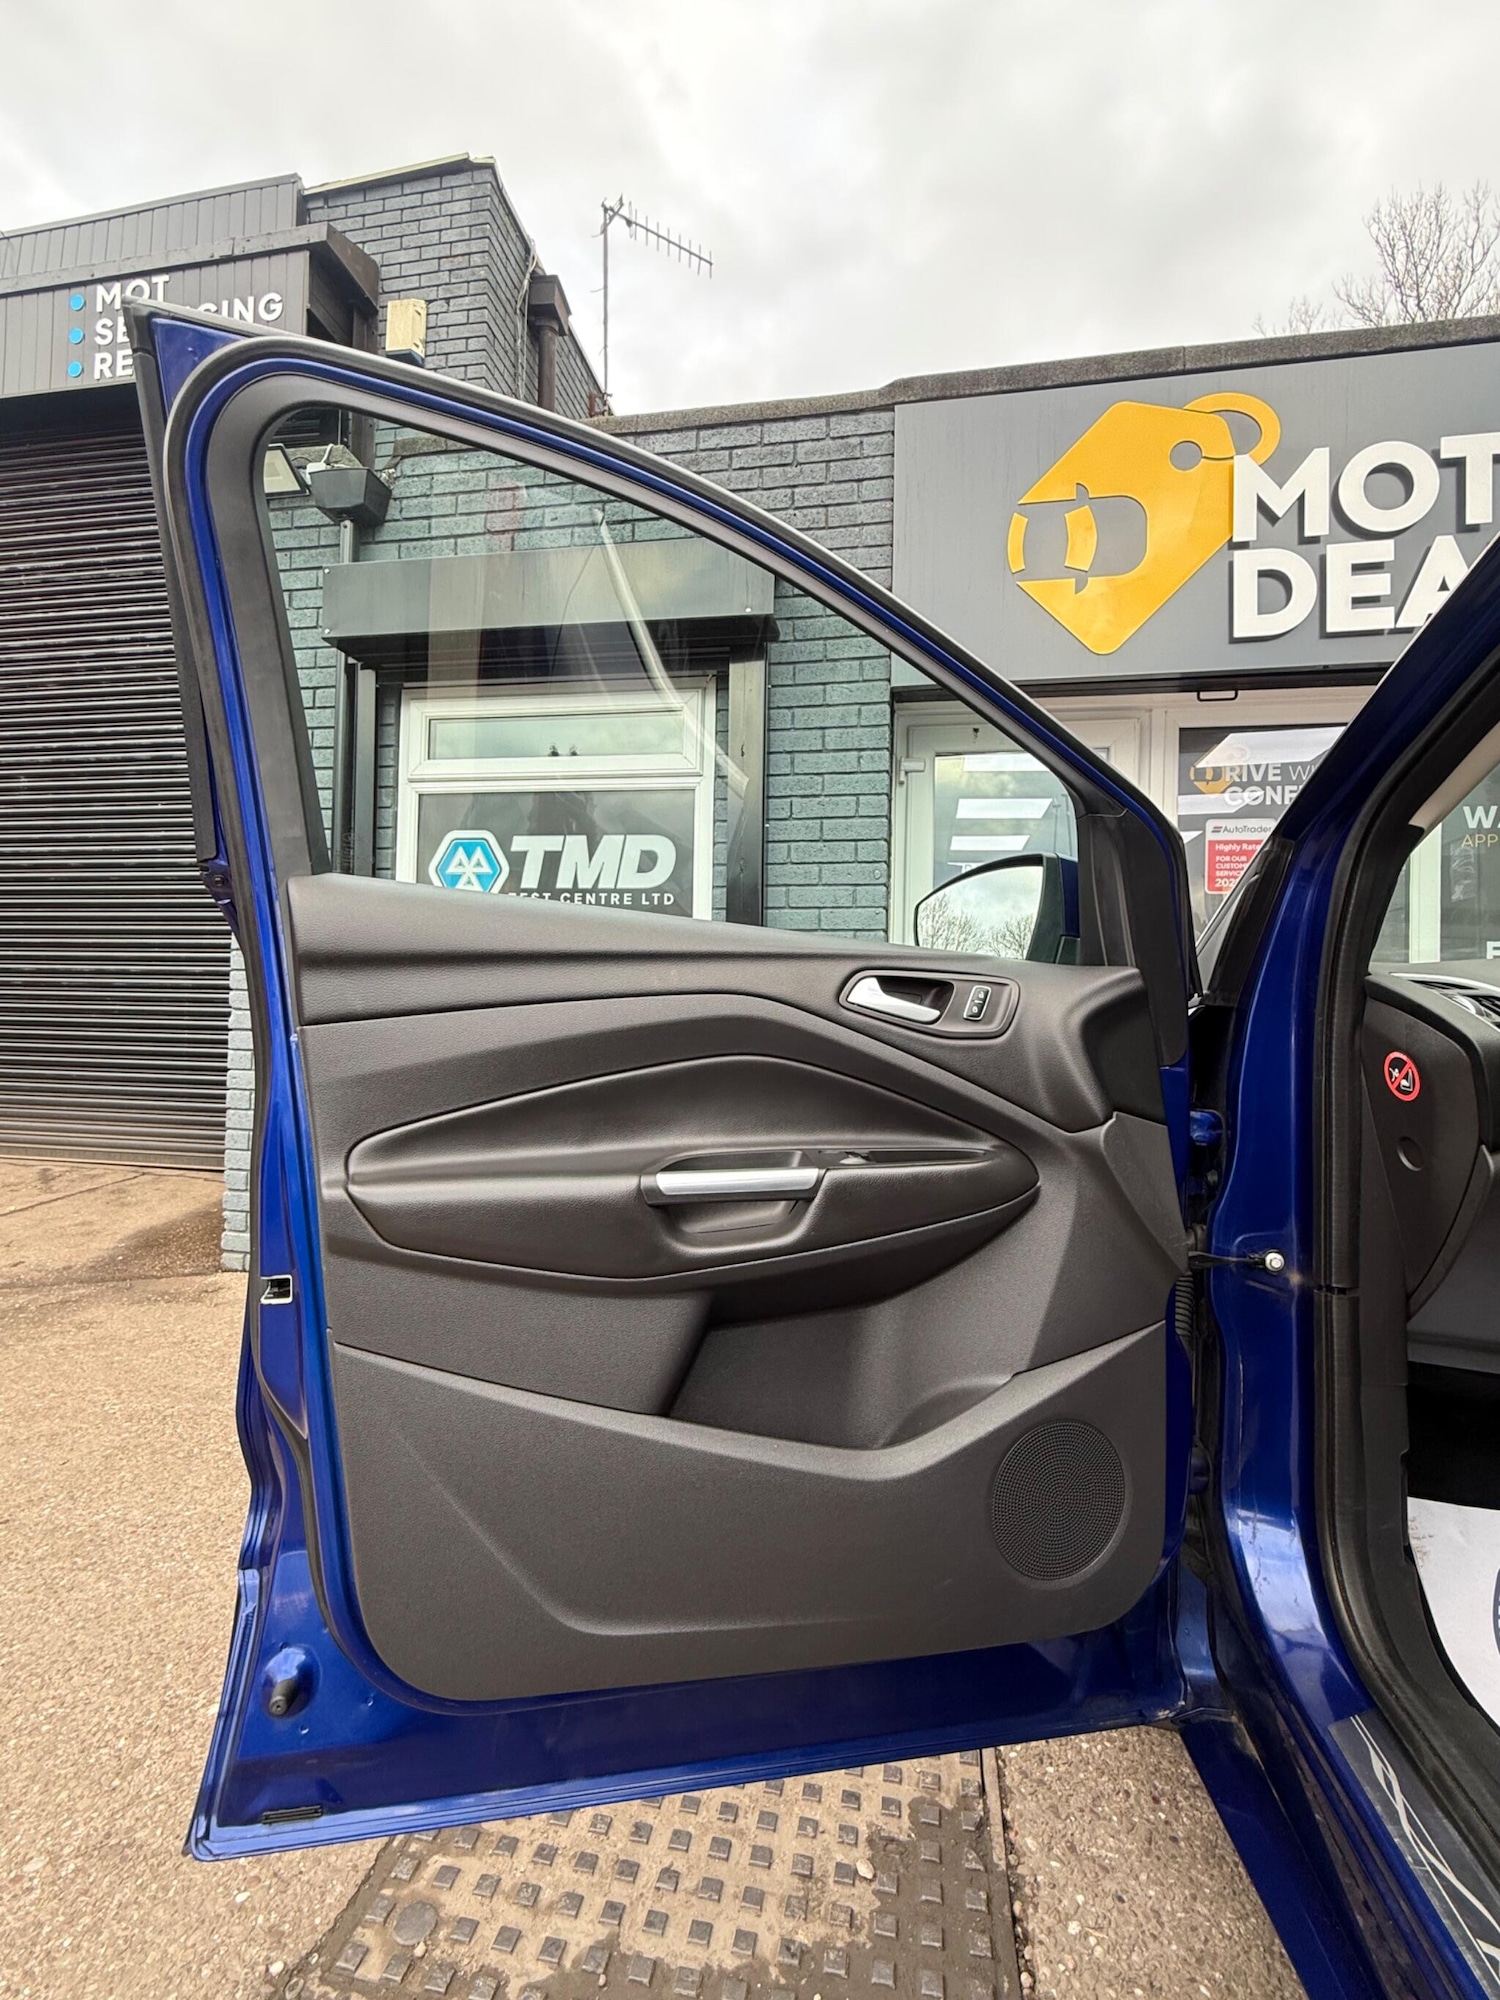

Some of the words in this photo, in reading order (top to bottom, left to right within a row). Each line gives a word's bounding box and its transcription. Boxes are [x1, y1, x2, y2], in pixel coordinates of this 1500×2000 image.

[95, 274, 170, 313] MOT
[1215, 843, 1241, 852] Highly
[510, 834, 677, 889] TMD
[1215, 877, 1238, 888] 202
[508, 892, 551, 900] ST
[560, 892, 633, 905] CENTRE
[641, 892, 675, 905] LTD
